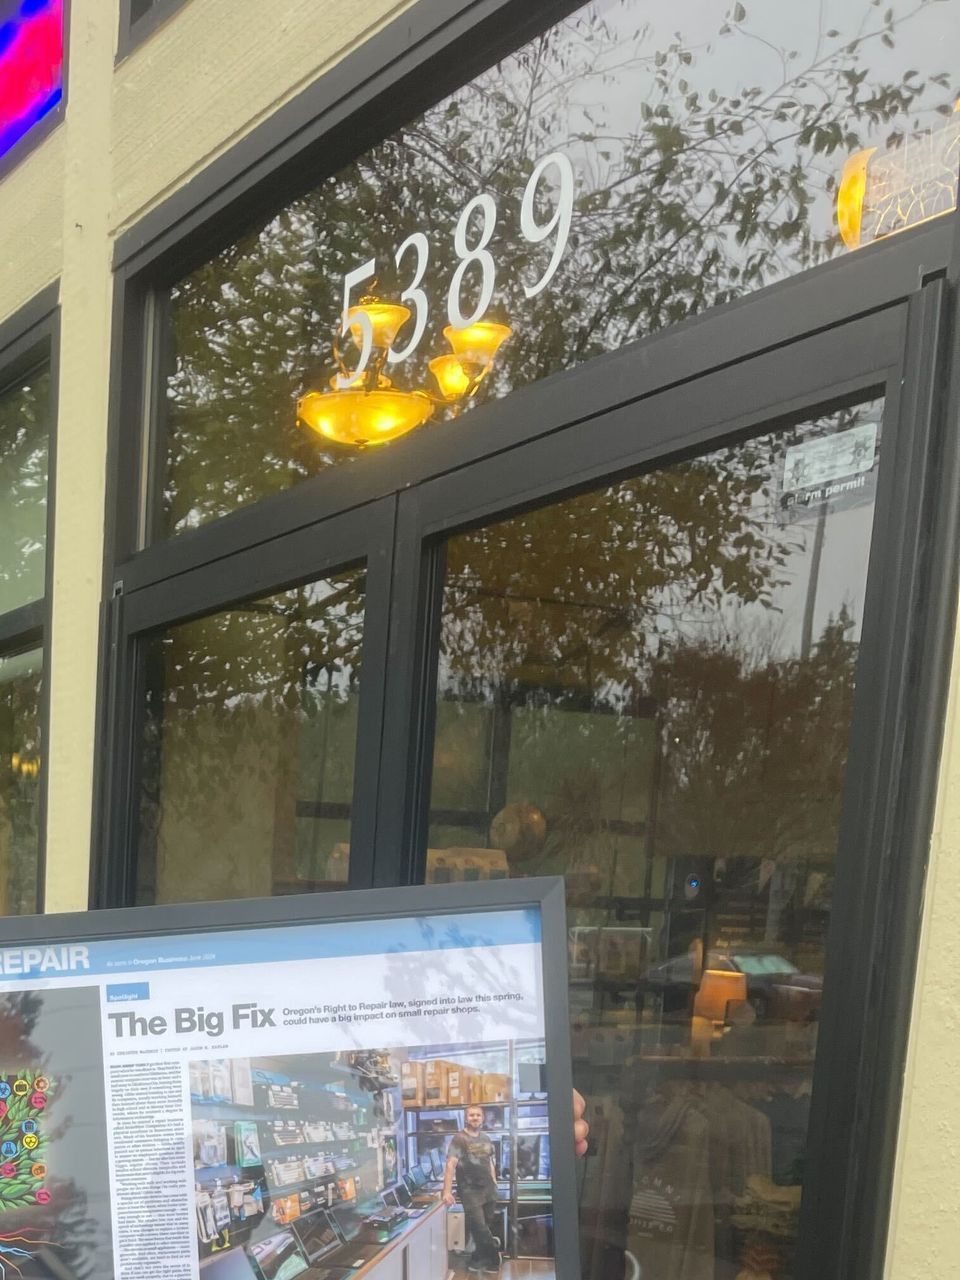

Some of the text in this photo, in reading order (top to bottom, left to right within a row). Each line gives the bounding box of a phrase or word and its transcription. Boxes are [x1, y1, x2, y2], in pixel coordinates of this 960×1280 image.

[337, 152, 574, 389] 5389
[825, 476, 865, 498] permit
[282, 993, 524, 1017] Oregon's Right to Repair law, signed into law this spring,
[283, 1016, 308, 1026] could
[309, 1015, 329, 1024] have
[338, 1013, 352, 1023] big
[354, 1011, 383, 1022] impact
[398, 1008, 421, 1018] small
[423, 1007, 449, 1018] repair
[451, 1006, 480, 1016] shops.
[108, 1002, 277, 1038] The Big Fix
